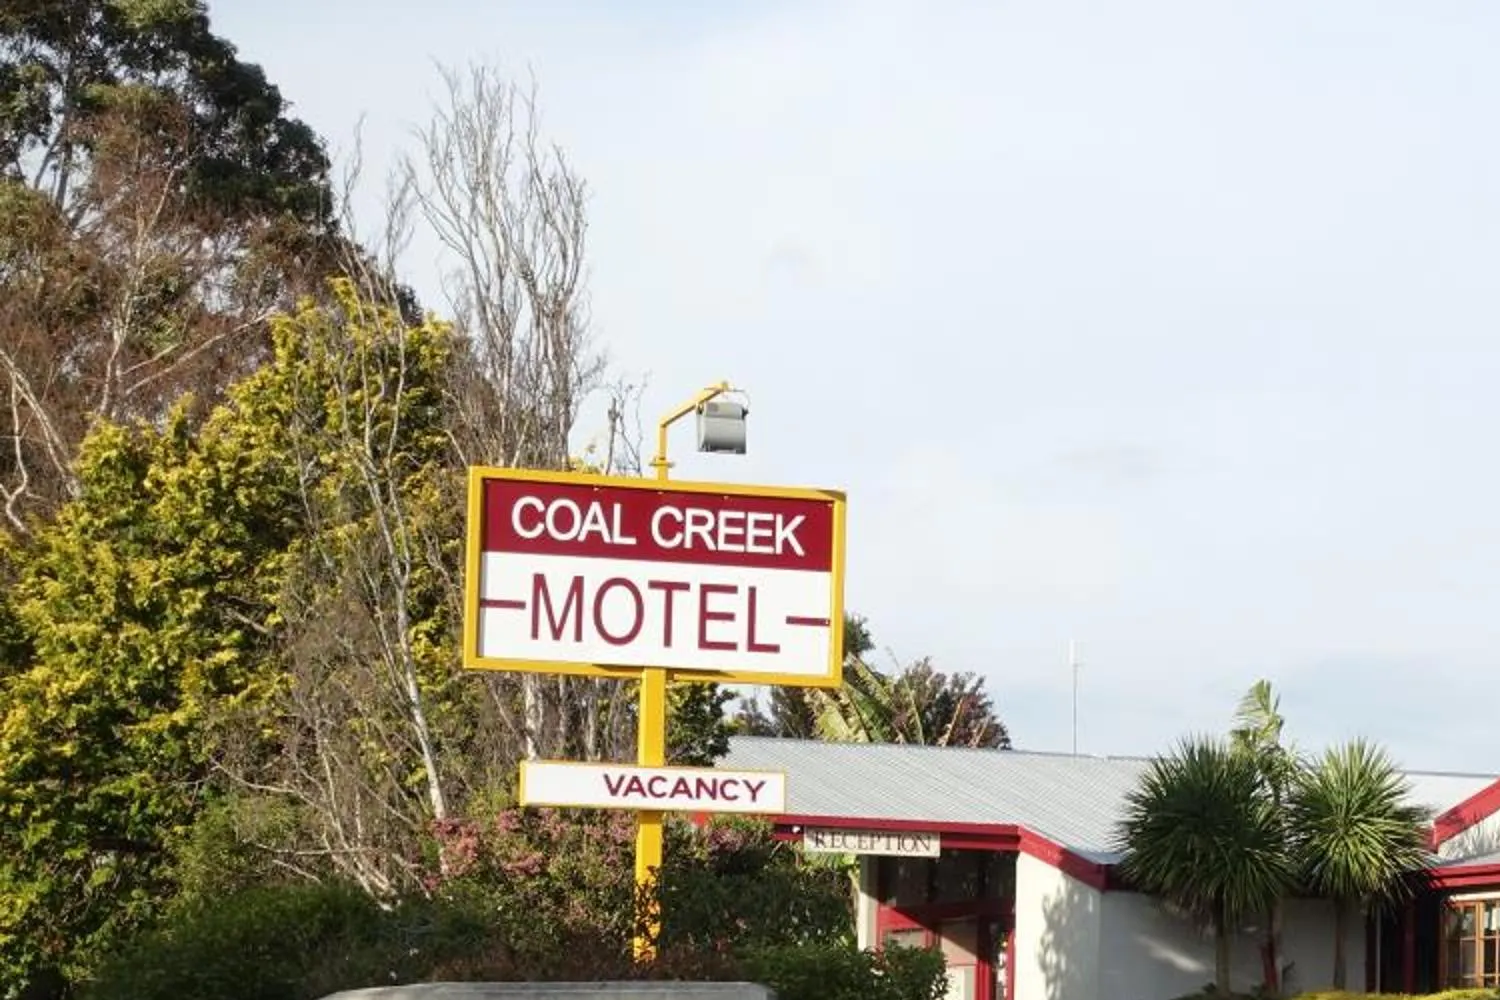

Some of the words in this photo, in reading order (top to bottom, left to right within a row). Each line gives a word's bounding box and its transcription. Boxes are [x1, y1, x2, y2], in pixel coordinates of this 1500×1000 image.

[511, 496, 637, 546] COAL
[651, 506, 805, 557] CREEK
[530, 573, 781, 654] MOTEL
[603, 773, 766, 803] VACANCY
[813, 831, 932, 853] RECEPTION
